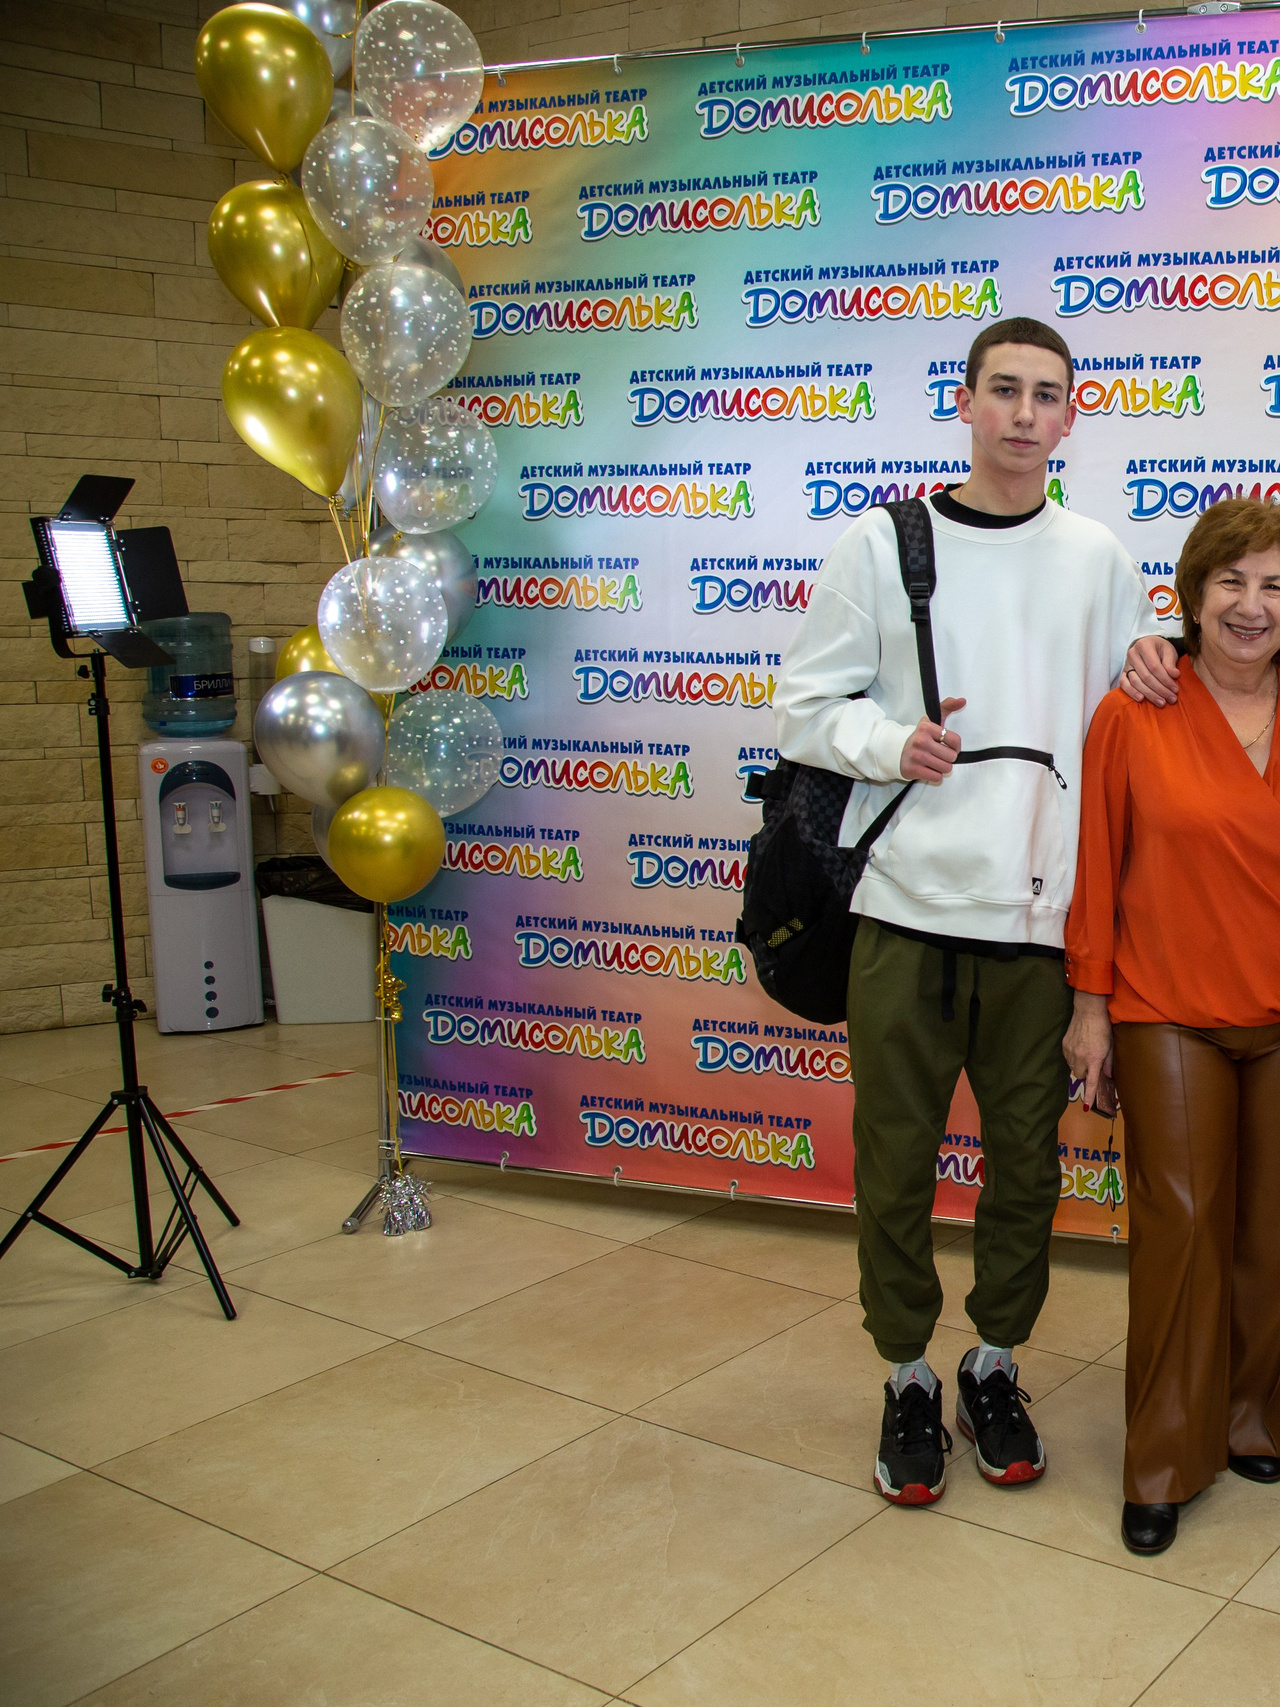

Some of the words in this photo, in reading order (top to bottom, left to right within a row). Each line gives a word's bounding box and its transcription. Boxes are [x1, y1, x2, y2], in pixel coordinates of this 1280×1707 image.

[1007, 49, 1085, 72] ДЕТСКИЙ
[1090, 38, 1232, 65] МУЗЫКАЛЬНЫЙ
[697, 74, 767, 96] ДЕТСКИЙ
[771, 63, 898, 89] МУЗЫКАЛЬНЫЙ
[901, 62, 951, 79] ТЕАТР
[487, 88, 600, 112] МУЗЫКАЛЬНЫЙ
[604, 87, 648, 103] ТЕАТР
[872, 158, 947, 181] ДЕТСКИЙ
[951, 150, 1086, 174] МУЗЫКАЛЬНЫЙ
[1090, 150, 1143, 166] ТЕАТР
[578, 178, 644, 200] ДЕТСКИЙ
[648, 170, 768, 193] МУЗЫКАЛЬНЫЙ
[772, 169, 818, 185] ТЕАТР
[489, 189, 530, 204] ТЕАТР
[1052, 250, 1132, 271] ДЕТСКИЙ
[1137, 246, 1280, 267] МУЗЫКАЛЬНЫЙ
[743, 264, 814, 285] ДЕТСКИЙ
[818, 258, 946, 280] МУЗЫКАЛЬНЫЙ
[950, 258, 1000, 274] ТЕАТР
[468, 279, 531, 298] ДЕТСКИЙ
[534, 272, 648, 294] МУЗЫКАЛЬНЫЙ
[652, 273, 696, 287] ТЕАТР
[629, 365, 696, 384] ДЕТСКИЙ
[700, 361, 822, 380] МУЗЫКАЛЬНЫЙ
[826, 362, 873, 376] ТЕАТР
[1149, 355, 1202, 369] ТЕАТР
[539, 371, 581, 385] ТЕАТР
[520, 462, 583, 479] ДЕТСКИЙ
[587, 459, 703, 476] МУЗЫКАЛЬНЫЙ
[707, 461, 752, 475] ТЕАТР
[804, 458, 876, 476] ДЕТСКИЙ
[881, 460, 972, 473] МУЗЫКАЛЬ
[1125, 456, 1206, 474] ДЕТСКИЙ
[483, 554, 593, 569] МУЗЫКАЛЬНЫЙ
[596, 556, 639, 569] ТЕАТР
[690, 554, 758, 571] ДЕТСКИЙ
[486, 646, 525, 659] ТЕАТР
[574, 647, 639, 662] ДЕТСКИЙ
[643, 649, 760, 665] МУЗЫКАЛЬНЫЙ
[532, 737, 643, 754] МУЗЫКАЛЬНЫЙ
[646, 742, 689, 756] ТЕАТР
[538, 827, 578, 842] ТЕАТР
[628, 833, 693, 849] ДЕТСКИЙ
[429, 908, 467, 922] ТЕАТР
[515, 914, 577, 930] ДЕТСКИЙ
[582, 919, 695, 939] МУЗЫКАЛЬНЫЙ
[424, 993, 483, 1009] ДЕТСКИЙ
[487, 999, 596, 1020] МУЗЫКАЛЬНЫЙ
[600, 1009, 642, 1024] ТЕАТР
[693, 1017, 759, 1035] ДЕТСКИЙ
[763, 1024, 847, 1044] МУЗЫКАЛЬ
[398, 1073, 489, 1095] УЗЫКАЛЬНЫЙ
[493, 1084, 532, 1100] ТЕАТР
[580, 1094, 643, 1112] ДЕТСКИЙ
[648, 1101, 763, 1125] МУЗЫКАЛЬНЫЙ
[767, 1114, 812, 1130] ТЕАТР
